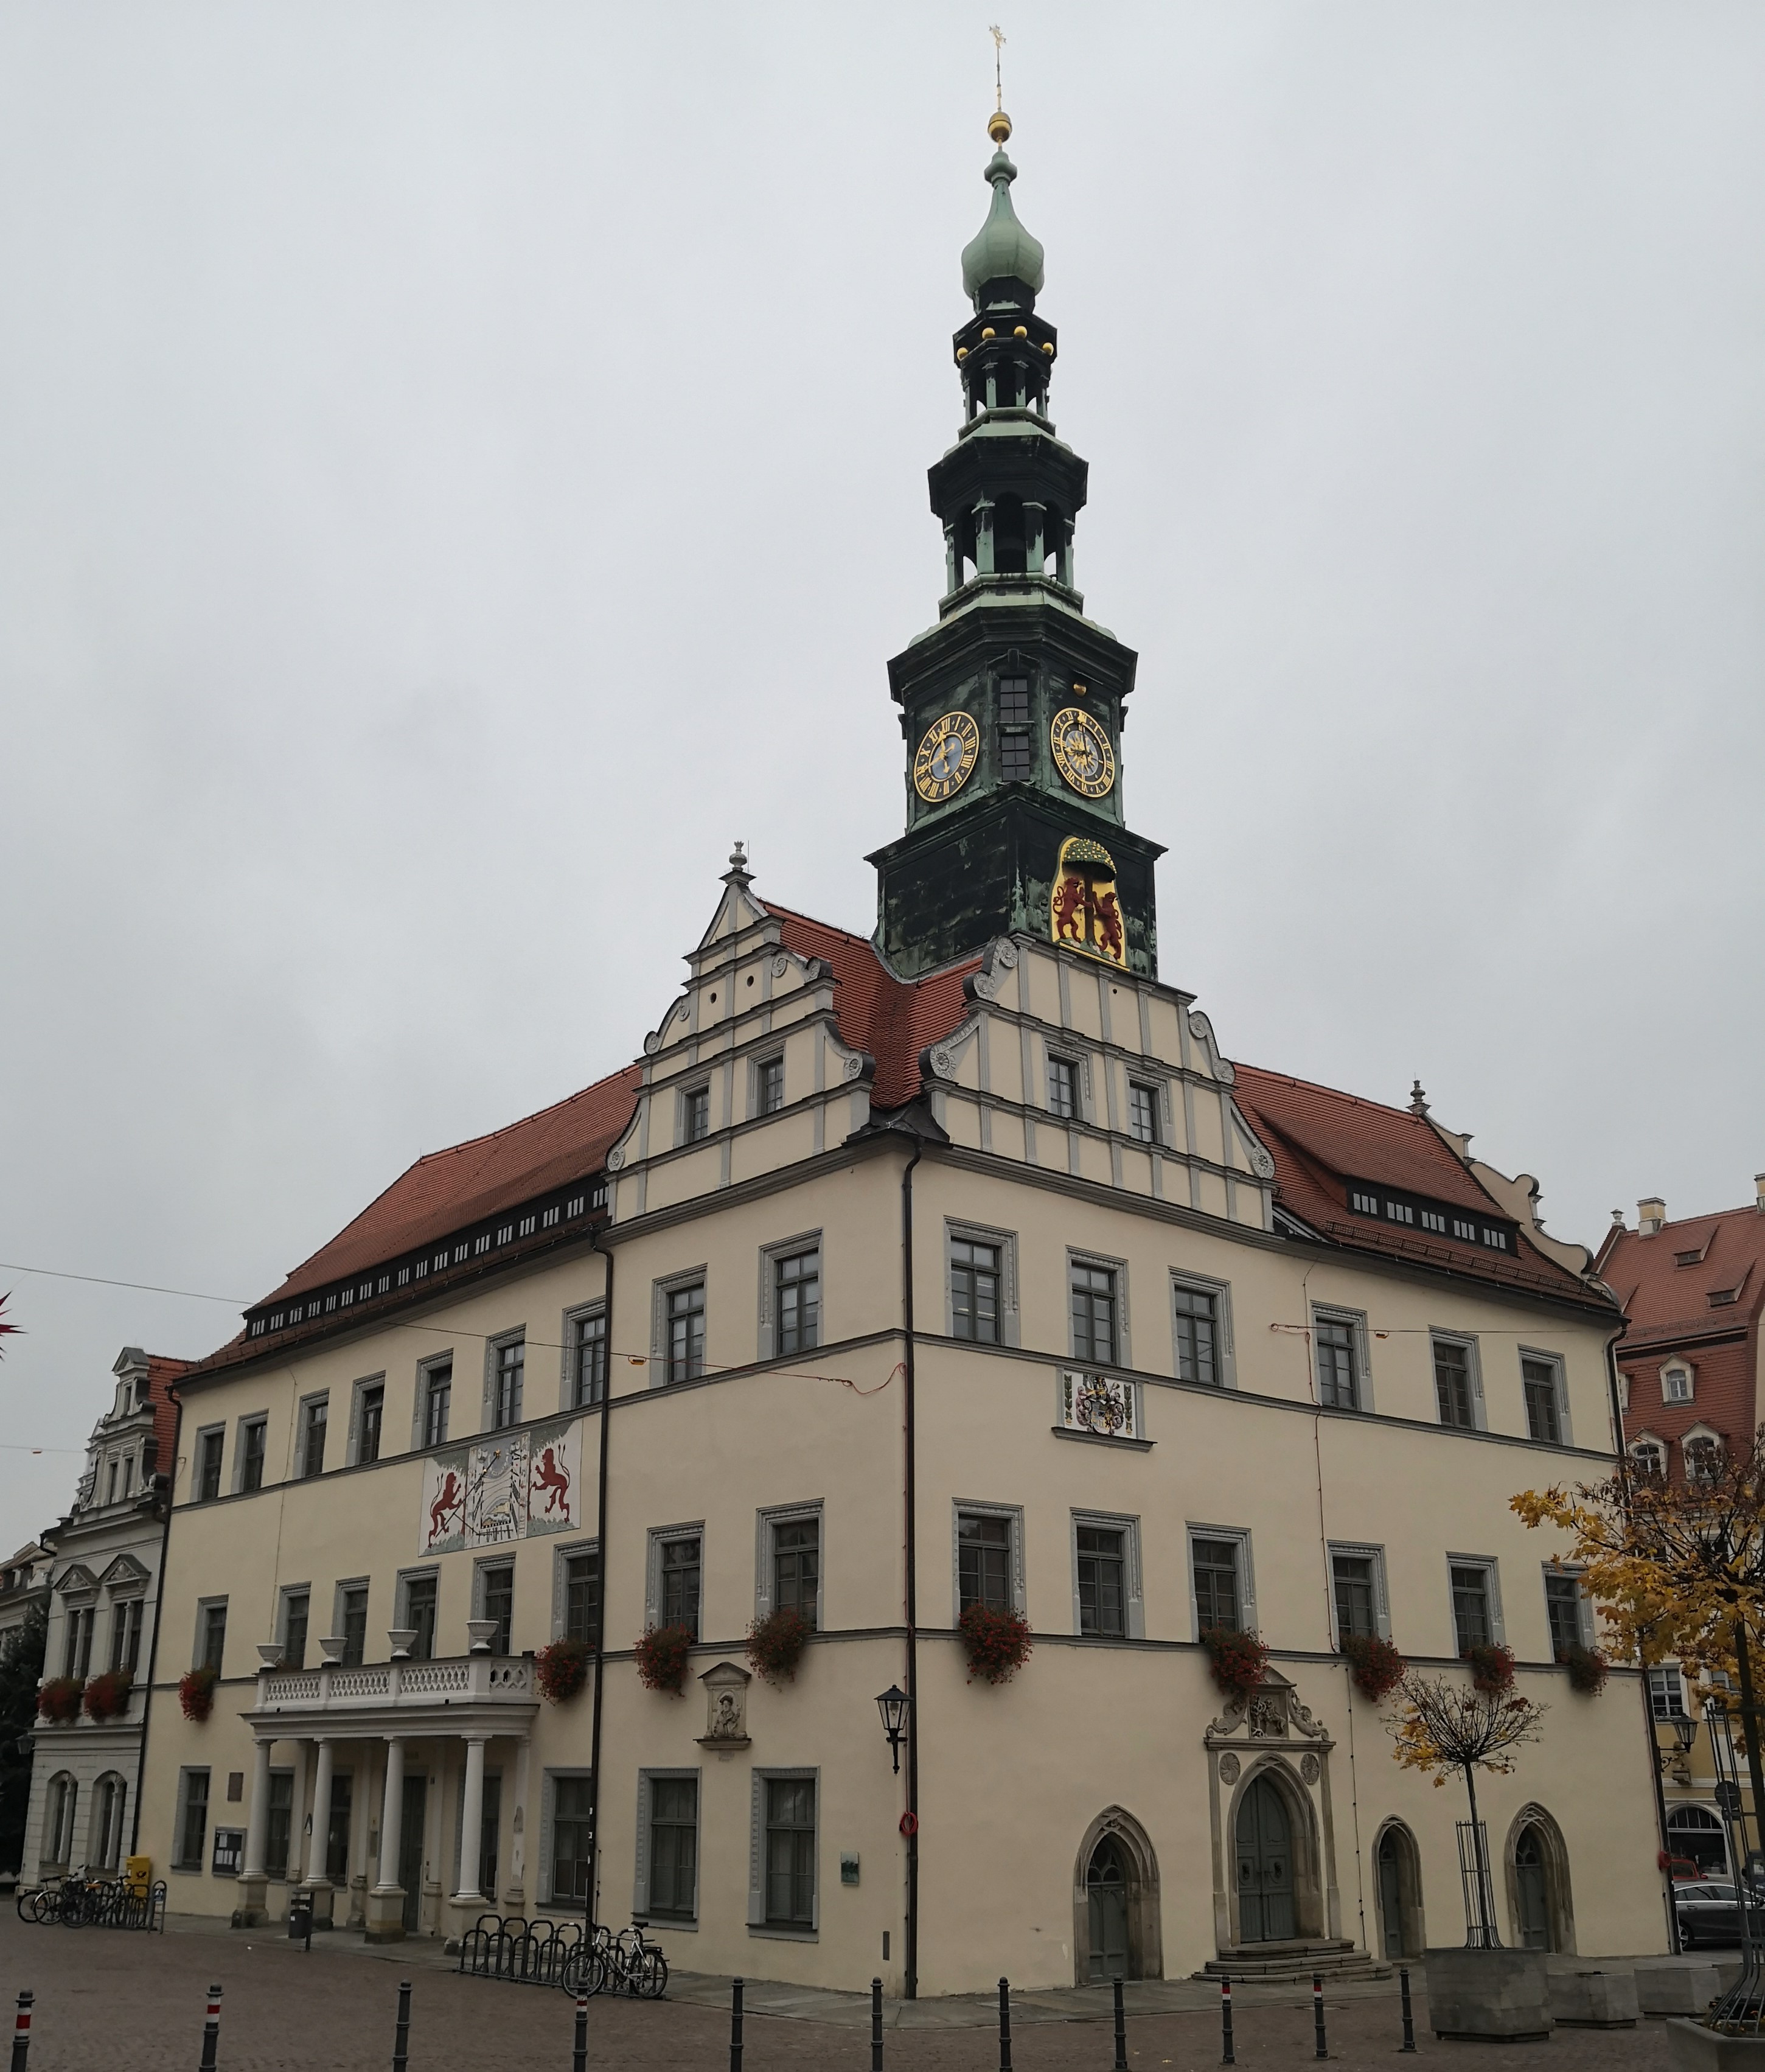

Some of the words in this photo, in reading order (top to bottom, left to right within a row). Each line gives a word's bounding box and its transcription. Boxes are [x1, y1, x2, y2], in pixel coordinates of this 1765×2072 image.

[941, 717, 950, 733] XII
[961, 723, 972, 737] II
[929, 730, 938, 744] XI
[965, 736, 976, 750] III
[961, 755, 973, 768] IIII
